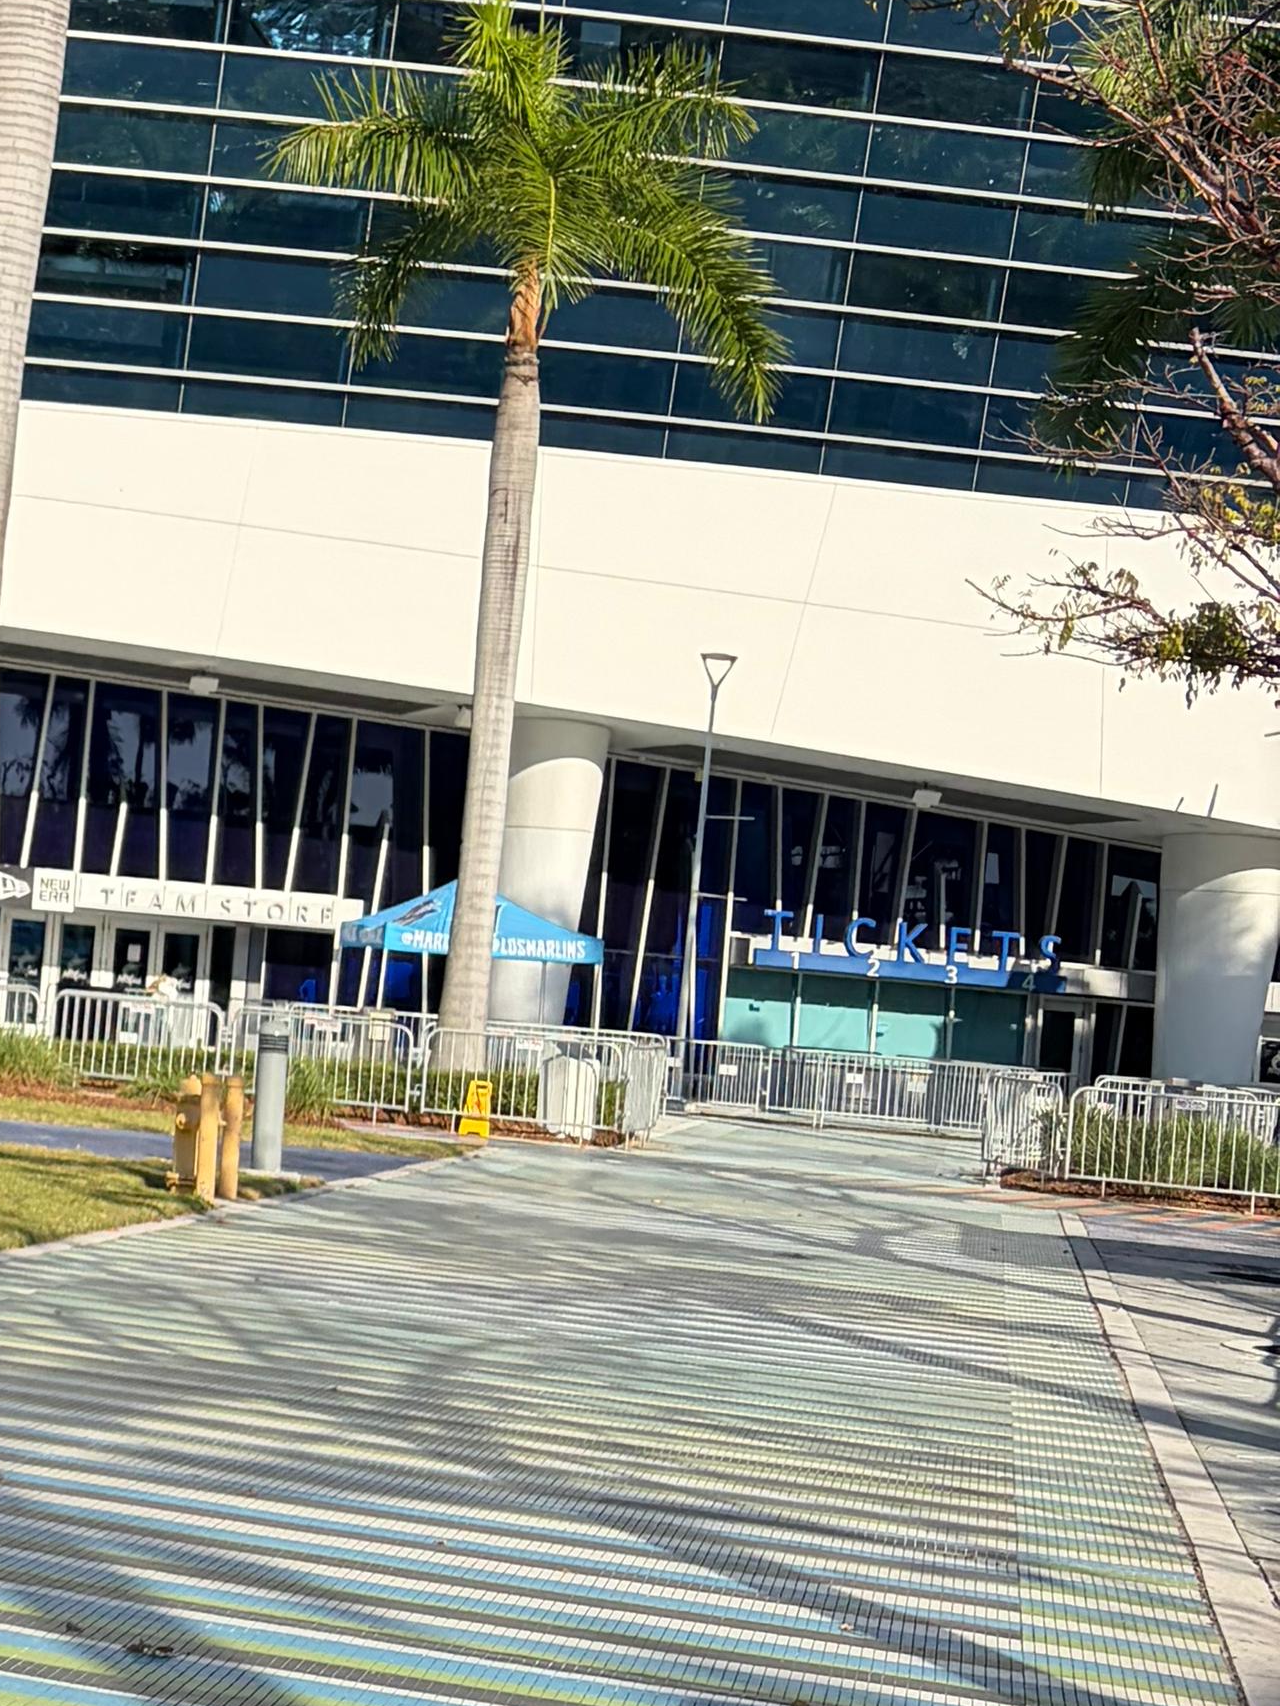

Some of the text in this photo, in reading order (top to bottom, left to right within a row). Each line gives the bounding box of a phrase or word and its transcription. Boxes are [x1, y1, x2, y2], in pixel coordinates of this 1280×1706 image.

[40, 877, 70, 891] NEW
[39, 890, 70, 904] ERA
[763, 908, 1063, 976] TICKETS
[791, 952, 800, 970] 1
[867, 959, 880, 978] 2
[944, 965, 958, 984] 3
[1022, 973, 1036, 991] 4
